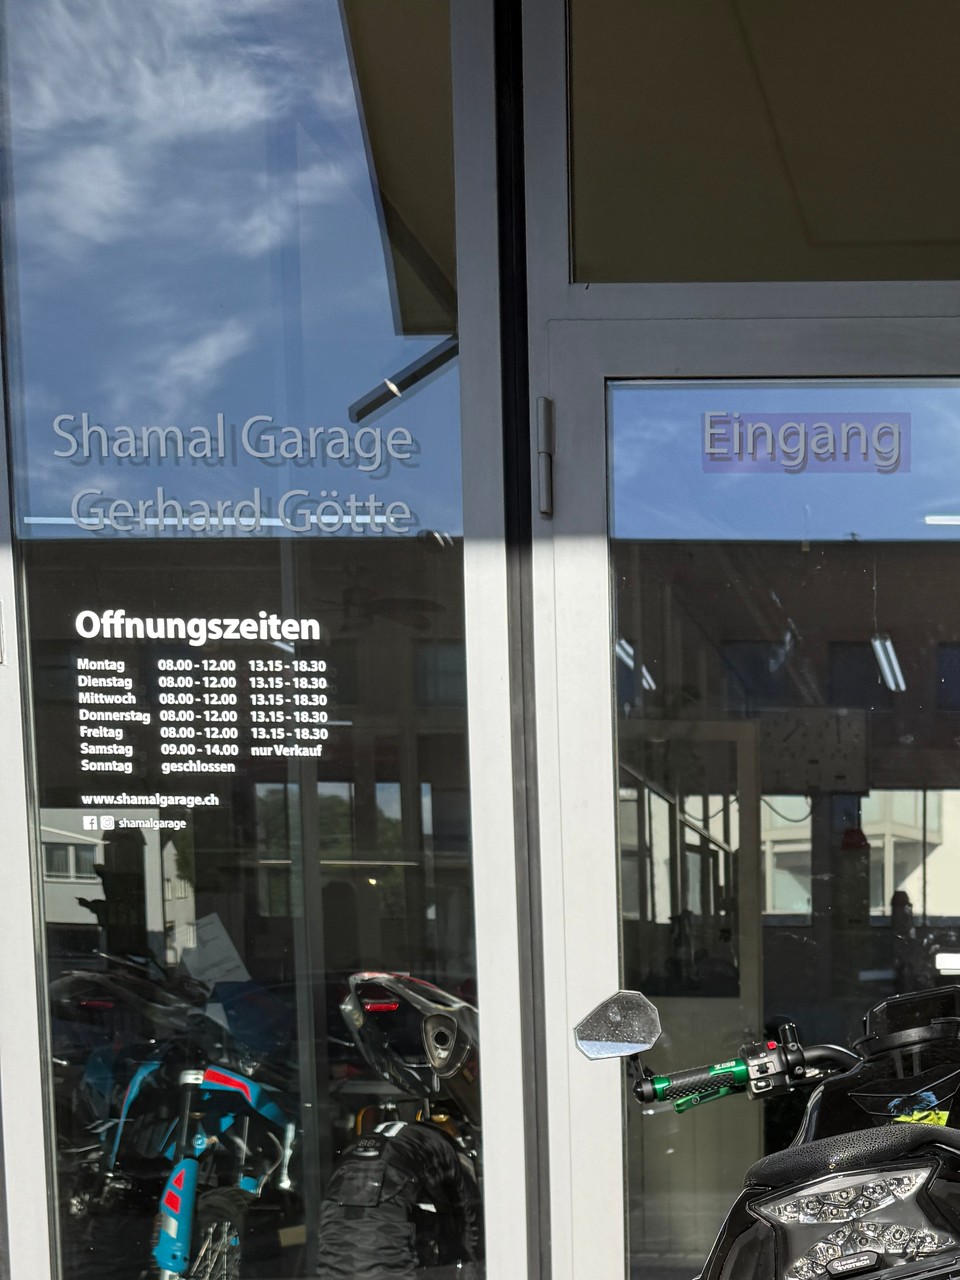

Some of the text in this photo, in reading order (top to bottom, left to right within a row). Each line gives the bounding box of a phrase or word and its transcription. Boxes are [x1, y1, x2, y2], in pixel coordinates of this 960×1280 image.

[53, 412, 413, 472] Shamal Garage
[704, 411, 900, 467] Eingang
[71, 486, 412, 533] Gerhard Götte
[77, 658, 125, 673] Montag
[158, 659, 193, 671] 08.00
[202, 660, 236, 671] 12.00
[249, 660, 283, 671] 13.15
[292, 660, 326, 672] 18.30
[78, 675, 132, 690] Dienstag
[158, 676, 193, 688] 08.00
[202, 677, 236, 688] 12.00
[249, 677, 283, 688] 13.15
[292, 677, 328, 689] 18.30
[79, 692, 136, 704] Mittwoch
[159, 693, 194, 704] 08.00
[203, 693, 237, 705] 12.00
[250, 694, 284, 705] 13.15
[293, 694, 327, 706] 18.30
[79, 709, 150, 724] Donnerstag
[160, 710, 194, 721] 08.00
[203, 710, 237, 722] 12.00
[250, 711, 284, 722] 13.15
[293, 711, 328, 723] 18.30
[80, 726, 123, 740] Freitag
[160, 727, 195, 738] 08.00
[204, 727, 238, 738] 12.00
[251, 728, 285, 739] 13.15
[294, 728, 328, 739] 18.30
[80, 743, 133, 757] Samstag
[161, 744, 195, 755] 09.00
[205, 744, 239, 755] 14.00
[251, 747, 272, 756] nur
[274, 745, 322, 756] Verkauf
[81, 759, 235, 774] Sonntag geschlossen
[81, 793, 219, 808] www.shamalgarage.ch
[118, 816, 187, 831] shamalgarage
